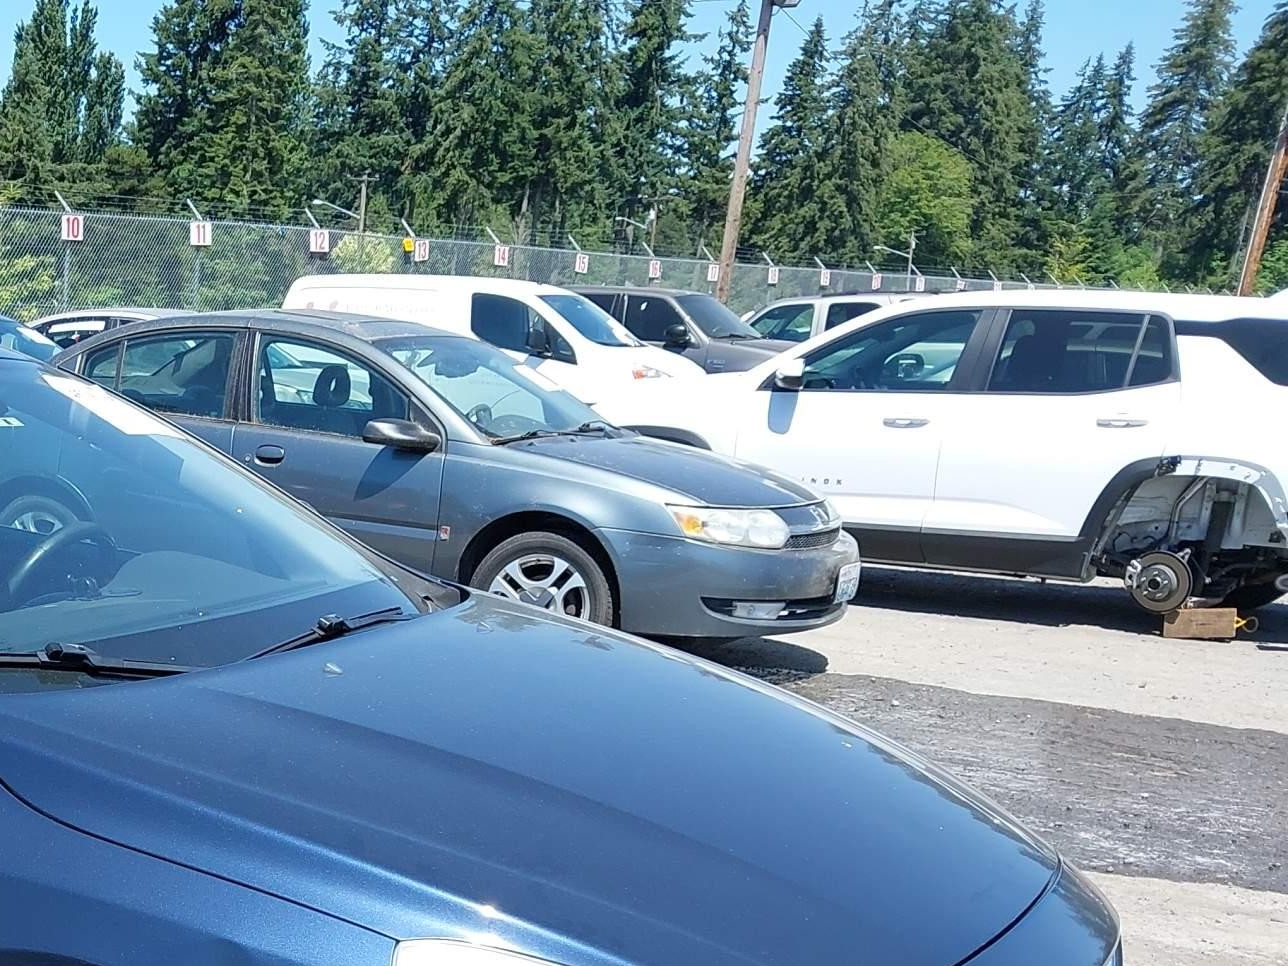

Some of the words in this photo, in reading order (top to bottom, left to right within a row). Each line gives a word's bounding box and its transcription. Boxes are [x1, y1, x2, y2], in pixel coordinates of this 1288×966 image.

[66, 216, 81, 240] 10
[195, 222, 208, 244] 11
[314, 230, 328, 251] 12
[417, 241, 427, 258] 13
[497, 247, 506, 263] 14
[578, 255, 586, 272] 15
[651, 261, 659, 277] 16
[710, 264, 717, 281] 17
